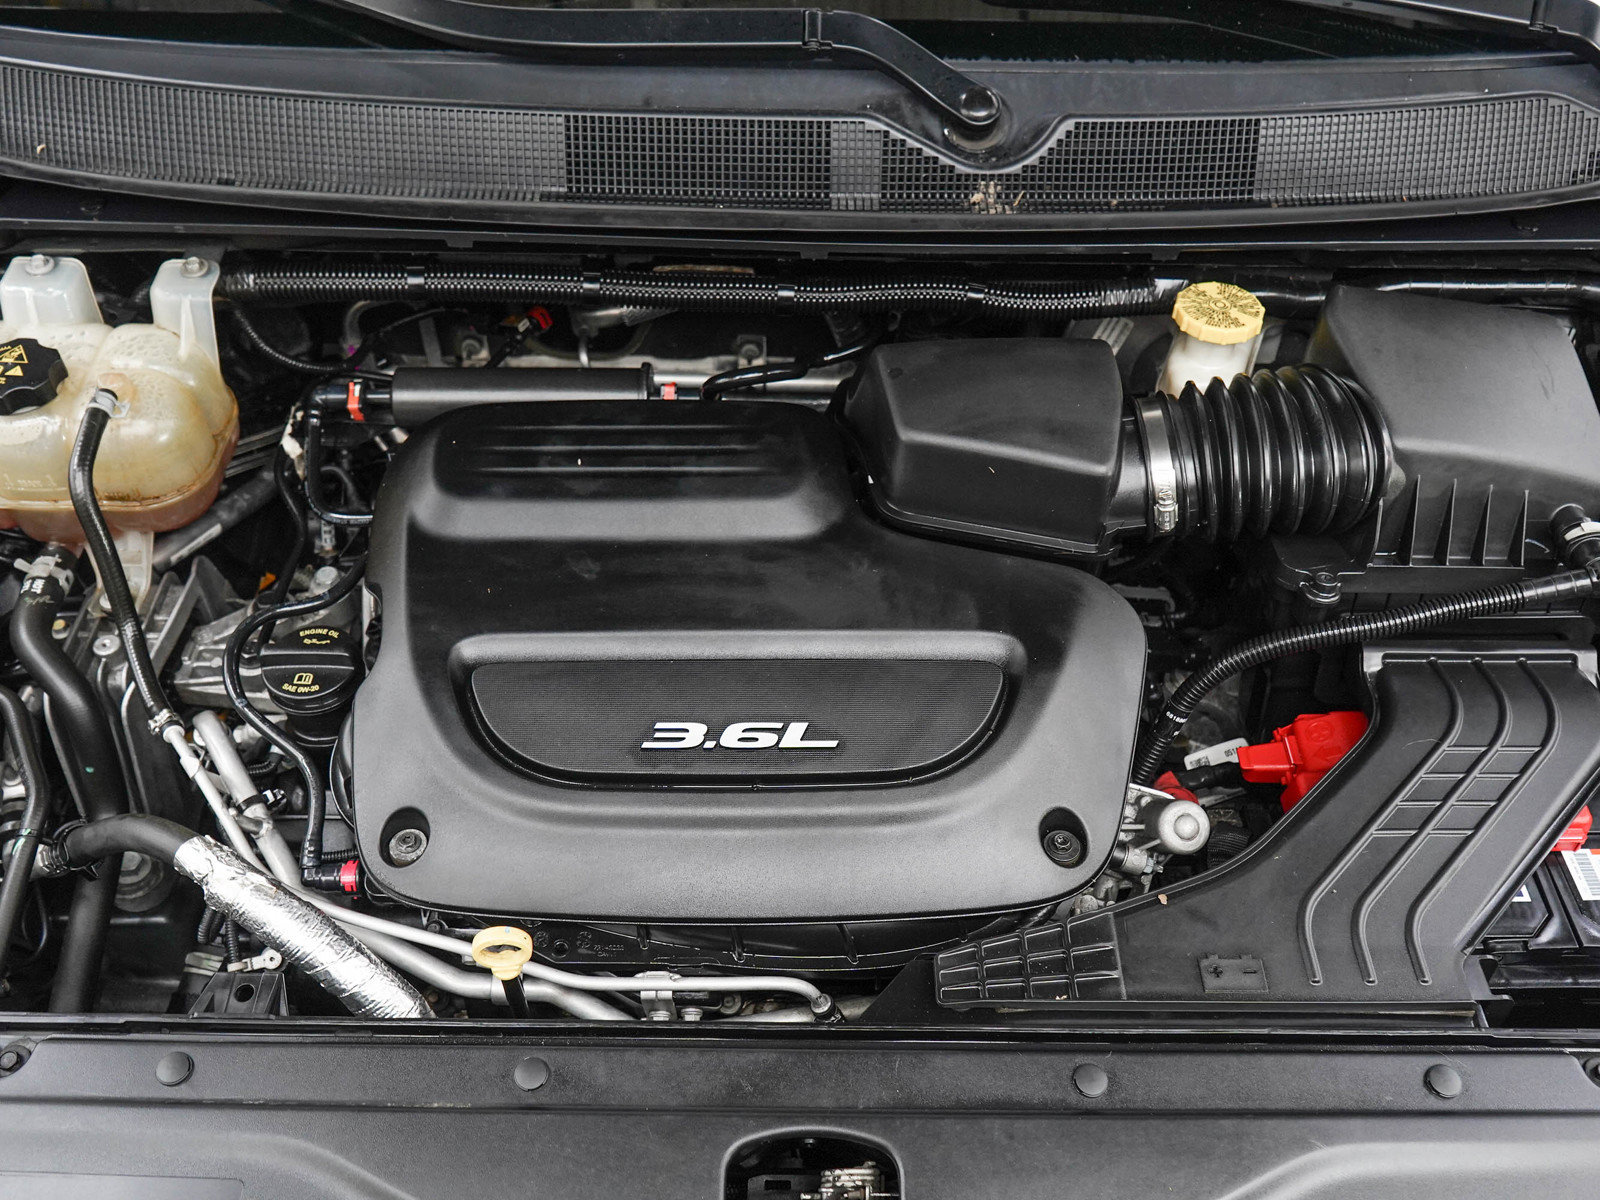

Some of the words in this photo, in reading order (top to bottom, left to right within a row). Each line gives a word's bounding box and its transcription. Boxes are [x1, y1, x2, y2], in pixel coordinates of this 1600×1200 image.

[299, 628, 328, 637] ENGINE
[328, 629, 340, 639] OIL
[282, 683, 297, 693] SAE
[297, 684, 320, 693] 0W-20
[640, 721, 840, 749] 3.6L
